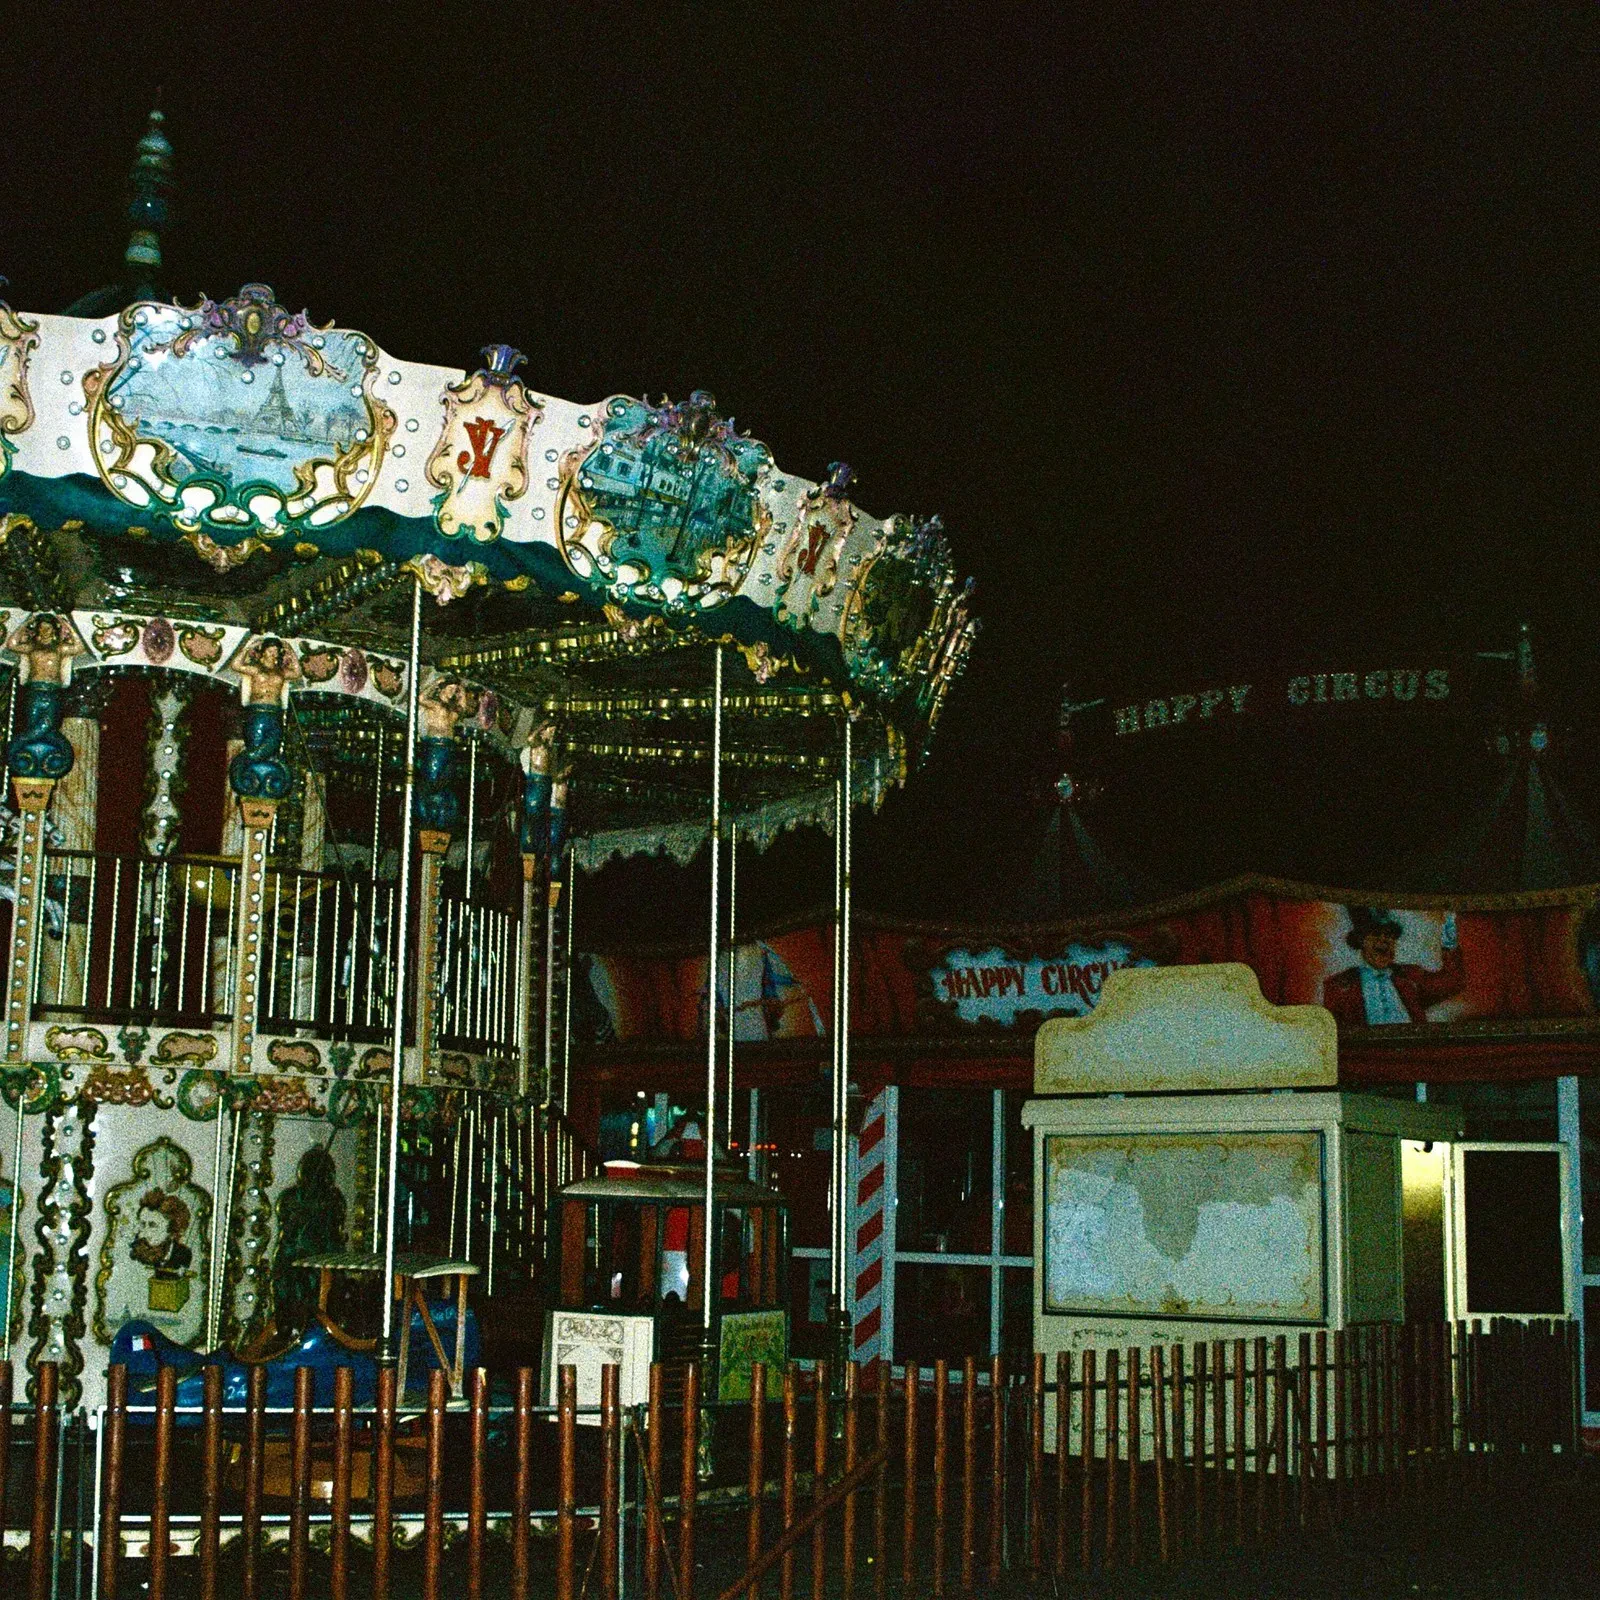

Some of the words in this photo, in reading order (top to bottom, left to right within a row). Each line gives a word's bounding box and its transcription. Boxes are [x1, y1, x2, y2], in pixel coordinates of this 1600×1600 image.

[1112, 684, 1252, 735] HAPPY
[1287, 669, 1451, 705] CIRCUS
[941, 965, 1026, 999] HAPPY
[1040, 960, 1128, 1009] CIRC
